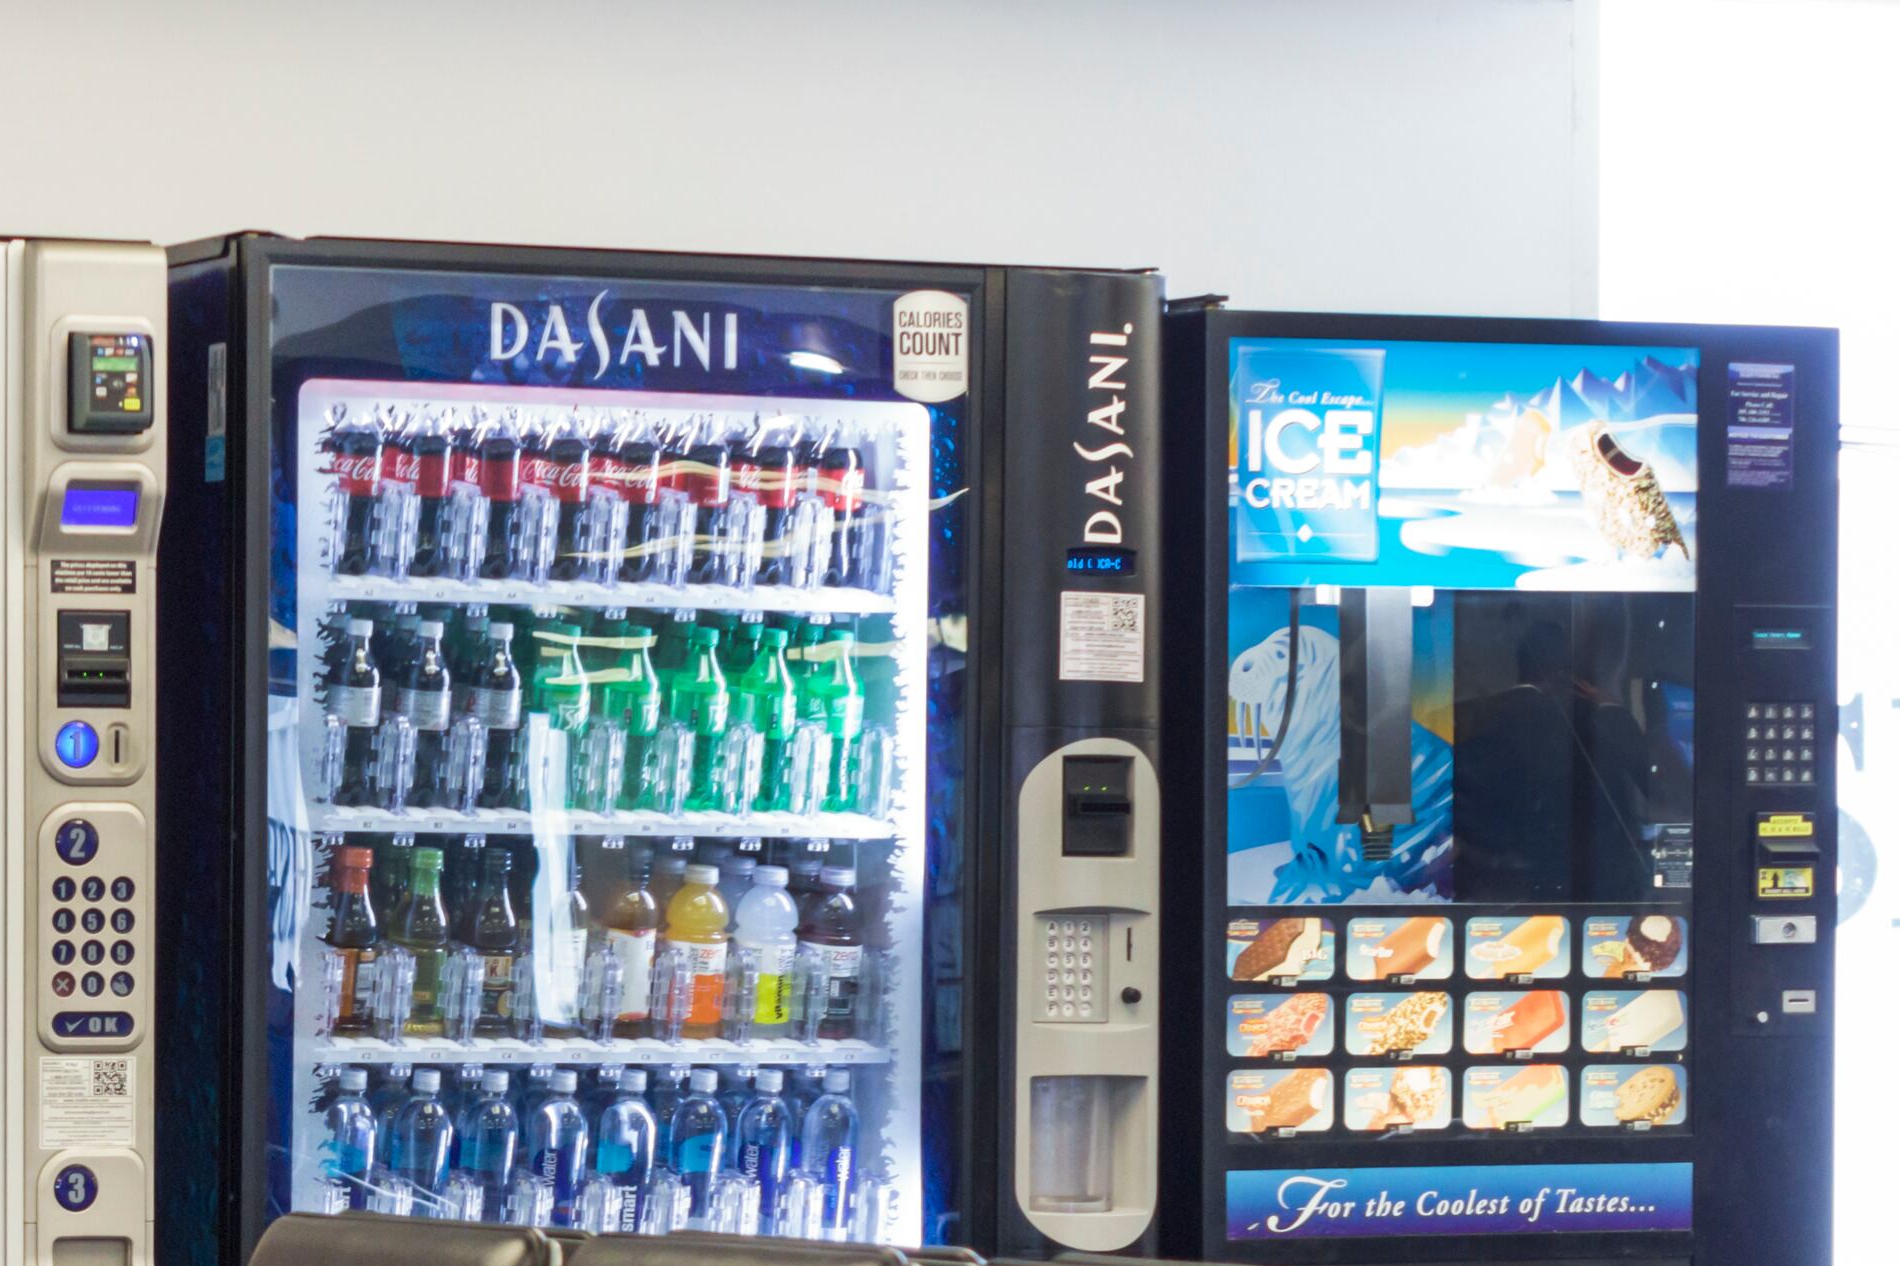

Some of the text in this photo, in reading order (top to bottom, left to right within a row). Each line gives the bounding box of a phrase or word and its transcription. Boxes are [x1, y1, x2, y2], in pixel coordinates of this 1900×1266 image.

[489, 288, 740, 379] DASANI
[898, 311, 963, 330] CALORIES
[899, 331, 963, 356] COUNT
[1245, 378, 1284, 404] The
[1288, 391, 1318, 405] Cool
[1073, 330, 1134, 544] DASANI
[1248, 408, 1374, 475] ICE
[1245, 477, 1371, 510] CREAM
[69, 729, 82, 760] 1
[68, 827, 87, 859] 2
[59, 882, 67, 899] 1
[87, 882, 97, 899] 2
[116, 882, 127, 899] 3
[57, 913, 67, 930] 4
[87, 913, 97, 930] 5
[116, 913, 127, 930] 6
[57, 944, 67, 962] 7
[87, 944, 97, 962] 8
[116, 944, 127, 962] 9
[88, 1016, 119, 1034] OK
[544, 1149, 557, 1188] water
[745, 1143, 759, 1178] water
[67, 1173, 85, 1204] 3
[621, 1185, 638, 1233] smart
[1266, 1176, 1656, 1233] For the Coolest of Tastes...
